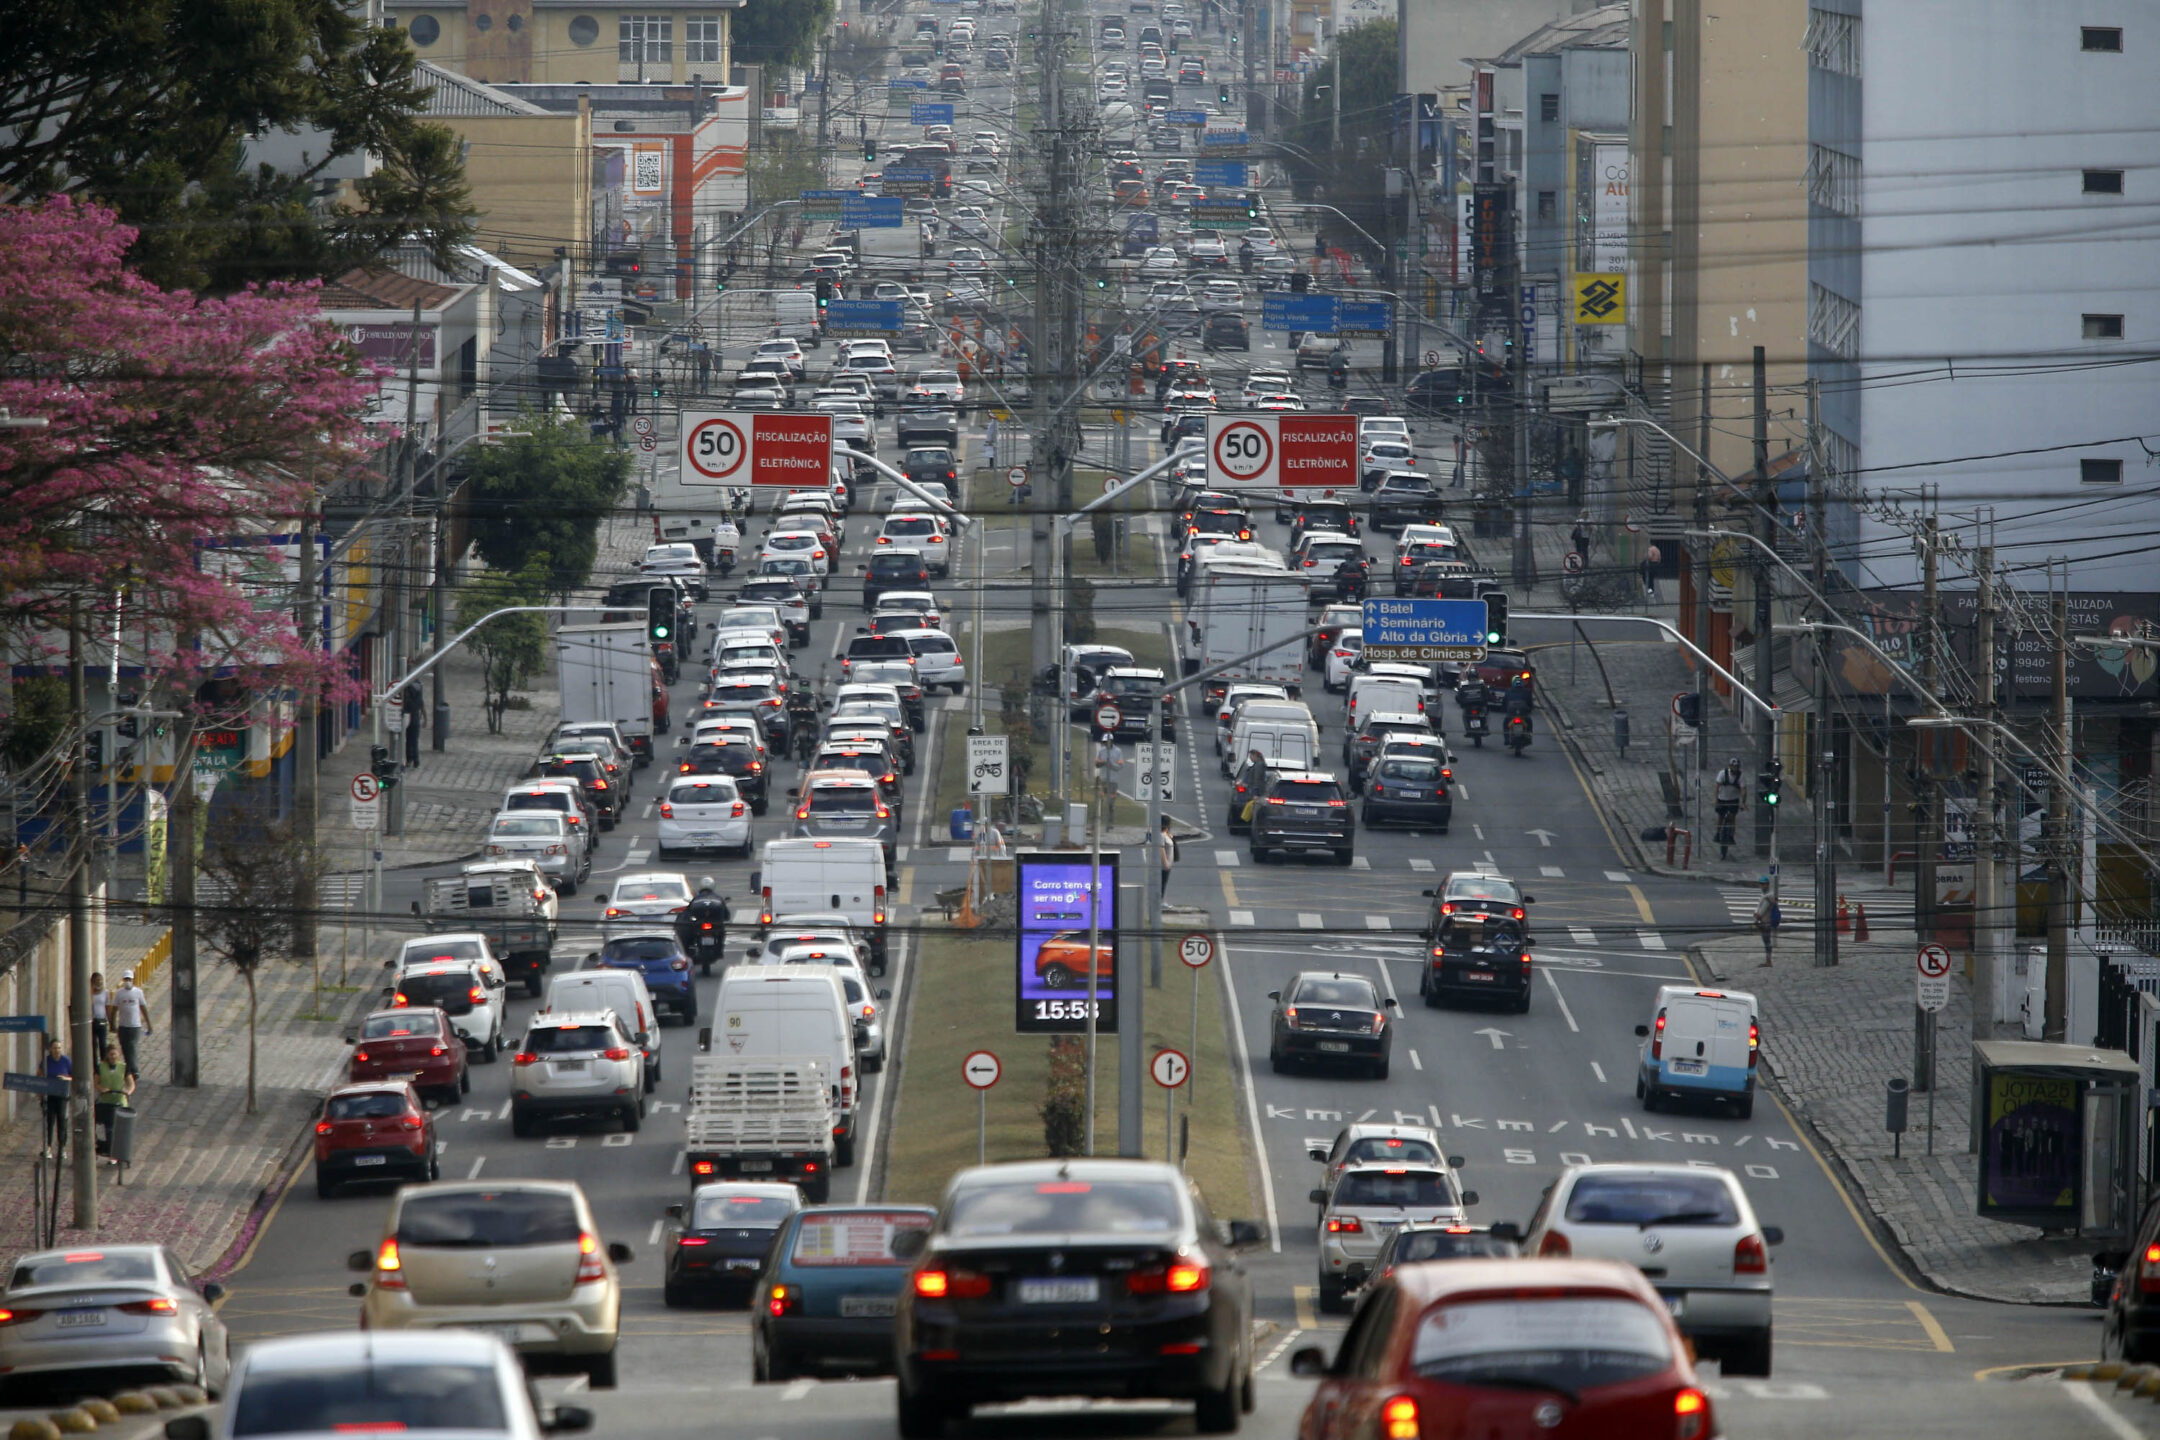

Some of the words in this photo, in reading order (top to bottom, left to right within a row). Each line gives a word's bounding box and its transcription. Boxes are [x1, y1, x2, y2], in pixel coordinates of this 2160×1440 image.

[700, 431, 735, 456] 50
[756, 432, 827, 444] FISCALIZAÇÃO
[1282, 431, 1354, 444] FISCALIZAÇÃO
[1226, 433, 1261, 459] 50
[760, 457, 821, 469] ELETRÔNICA
[1287, 457, 1348, 469] ELETRÔNICA
[1380, 603, 1413, 614] Batel
[1380, 617, 1446, 629] Seminário
[1380, 631, 1405, 642] Alto
[1409, 632, 1425, 642] da
[1429, 631, 1468, 643] Glória
[1364, 647, 1399, 660] Hosp.
[1401, 647, 1417, 658] de
[1033, 881, 1061, 890] Carro
[1063, 882, 1083, 890] tem
[1084, 882, 1102, 892] qe
[1033, 894, 1048, 903] ser
[1185, 940, 1208, 956] 50
[729, 1017, 741, 1028] 90
